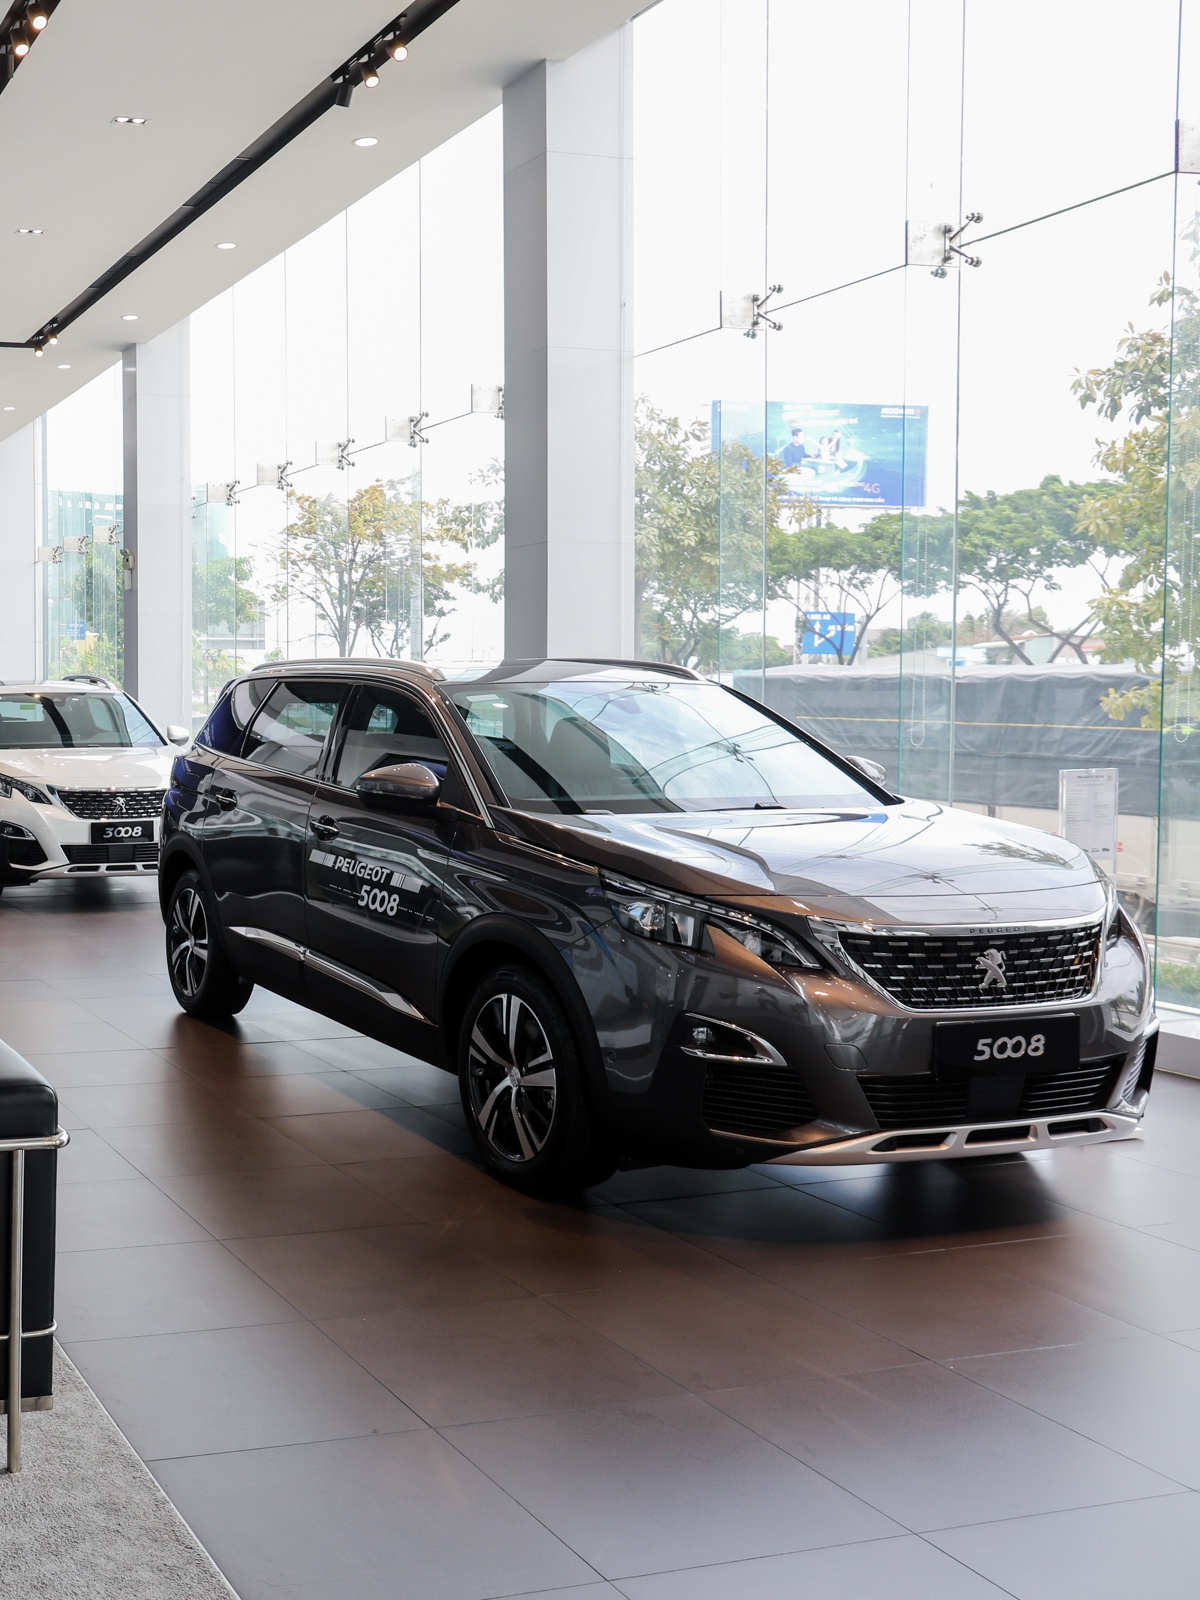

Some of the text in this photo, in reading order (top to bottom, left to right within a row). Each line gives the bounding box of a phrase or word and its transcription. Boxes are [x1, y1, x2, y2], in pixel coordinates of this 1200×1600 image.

[863, 483, 881, 494] 4G
[103, 826, 142, 839] 3008
[335, 856, 391, 884] PEUGEOT
[357, 884, 400, 917] 5008
[969, 926, 1028, 934] PEUGEOT
[973, 1034, 1046, 1061] 5008
